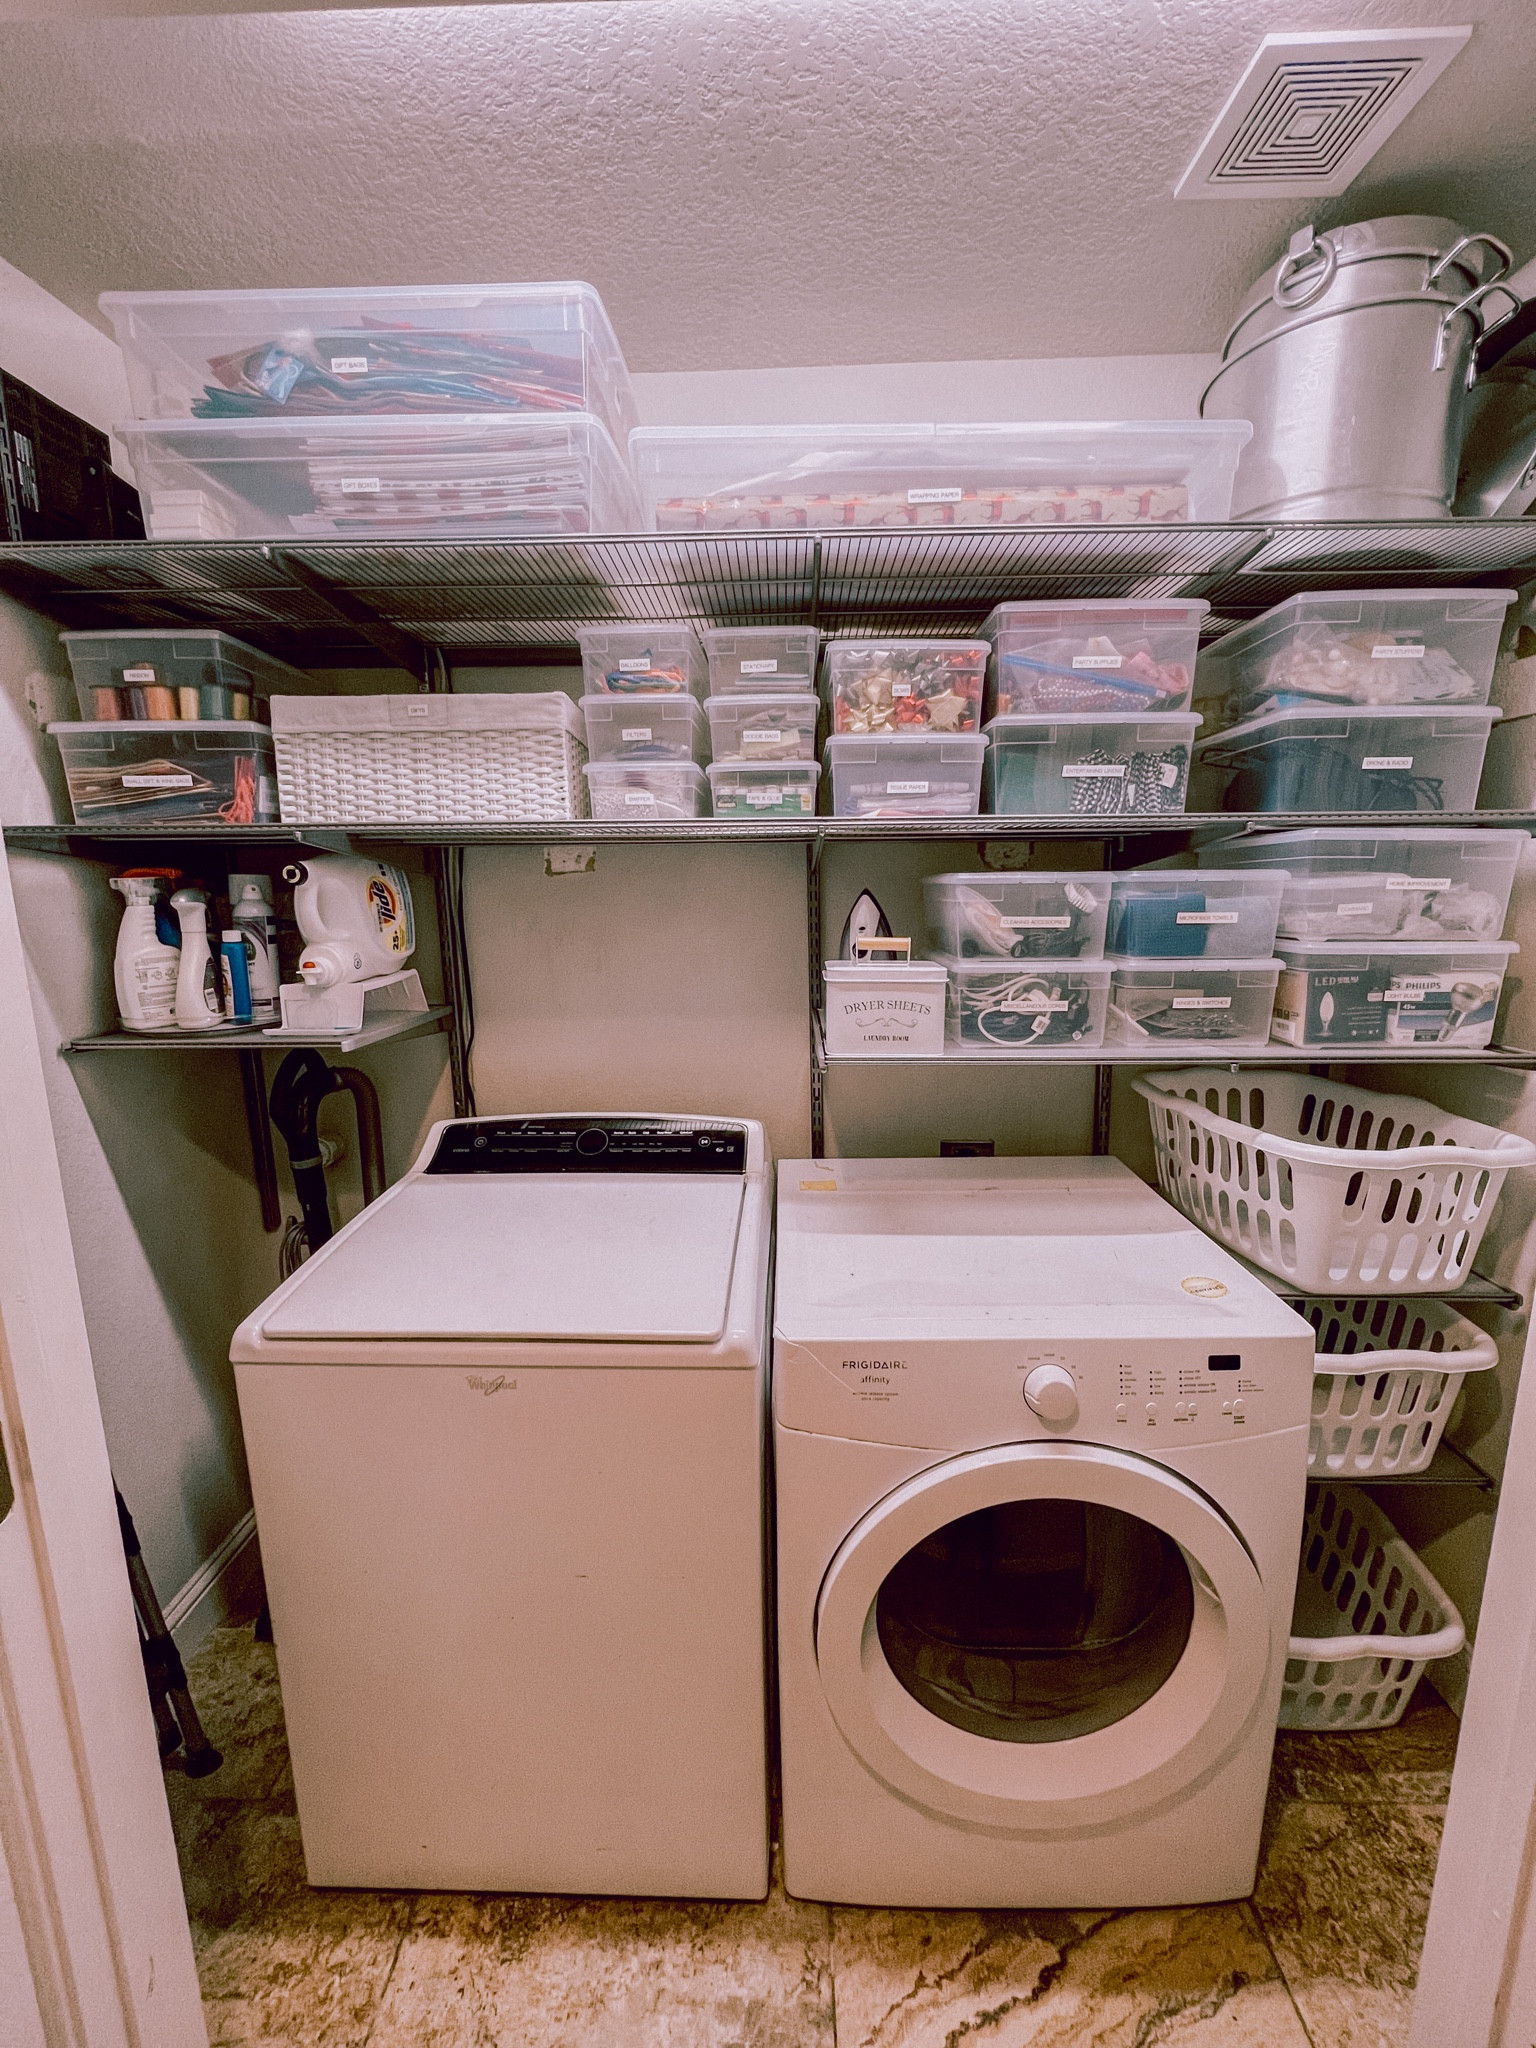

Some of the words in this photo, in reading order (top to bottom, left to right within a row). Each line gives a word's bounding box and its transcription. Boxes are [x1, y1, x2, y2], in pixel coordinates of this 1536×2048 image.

[358, 481, 378, 489] BOXES
[372, 880, 397, 921] Tide
[1314, 976, 1337, 987] LED
[1405, 982, 1441, 990] PHILIPS
[844, 1000, 885, 1015] DRYER
[887, 1000, 932, 1015] SHEETS
[842, 1360, 908, 1370] FRIGIDAIRE
[861, 1375, 890, 1385] affinity
[465, 1375, 517, 1396] Whirlpool
